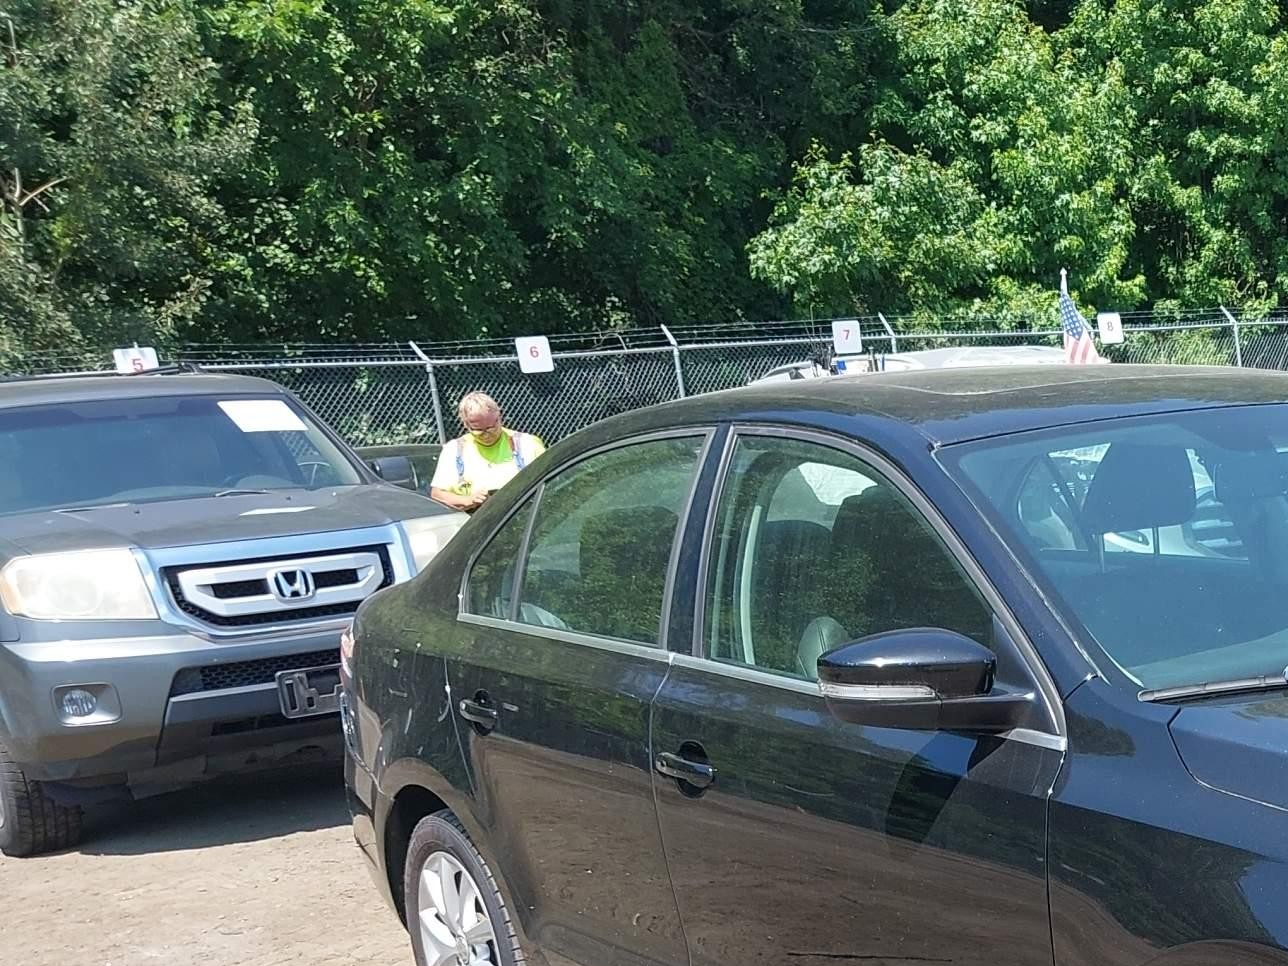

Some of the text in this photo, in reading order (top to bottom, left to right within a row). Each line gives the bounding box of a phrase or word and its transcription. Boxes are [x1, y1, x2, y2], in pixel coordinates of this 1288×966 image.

[842, 329, 850, 341] 7
[529, 345, 540, 359] 6
[131, 358, 145, 374] 5
